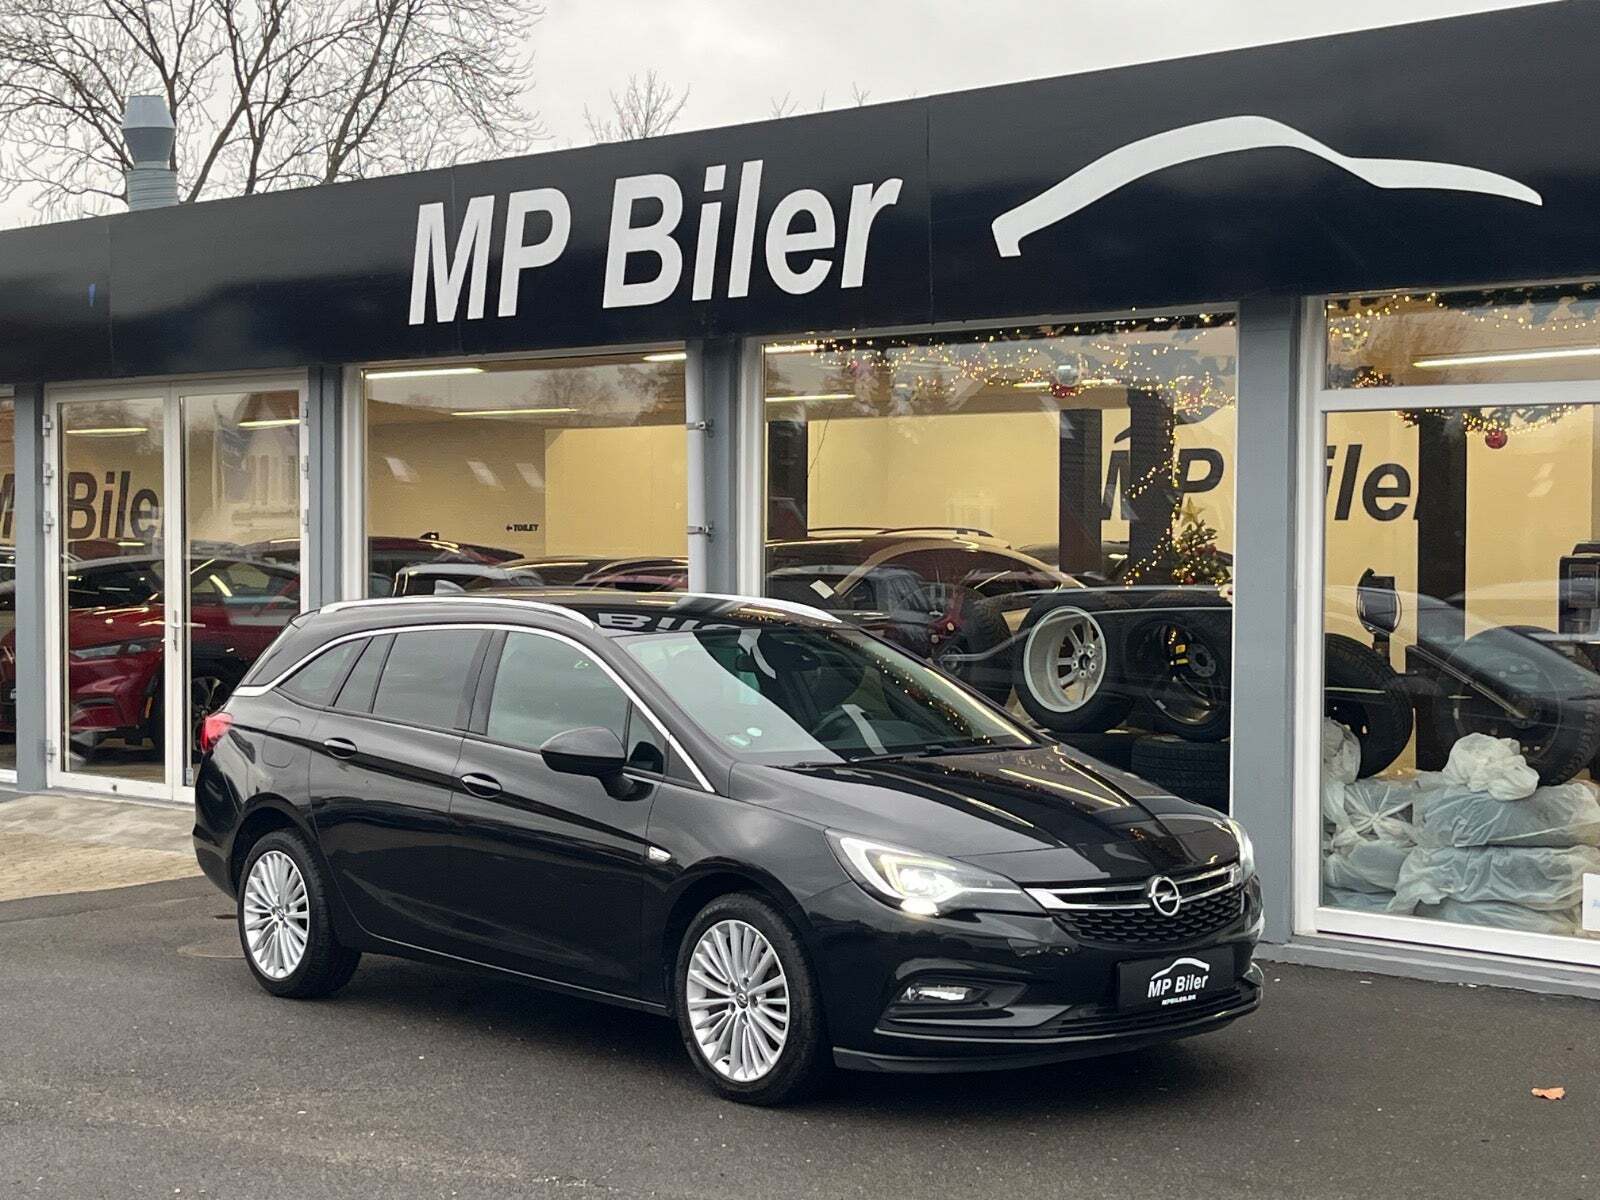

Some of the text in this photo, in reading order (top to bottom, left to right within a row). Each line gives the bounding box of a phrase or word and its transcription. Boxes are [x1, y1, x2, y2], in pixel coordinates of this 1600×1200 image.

[408, 159, 903, 325] MP Biler
[67, 471, 164, 540] Bile
[513, 523, 539, 532] TOILET
[1147, 974, 1209, 998] MP Biler
